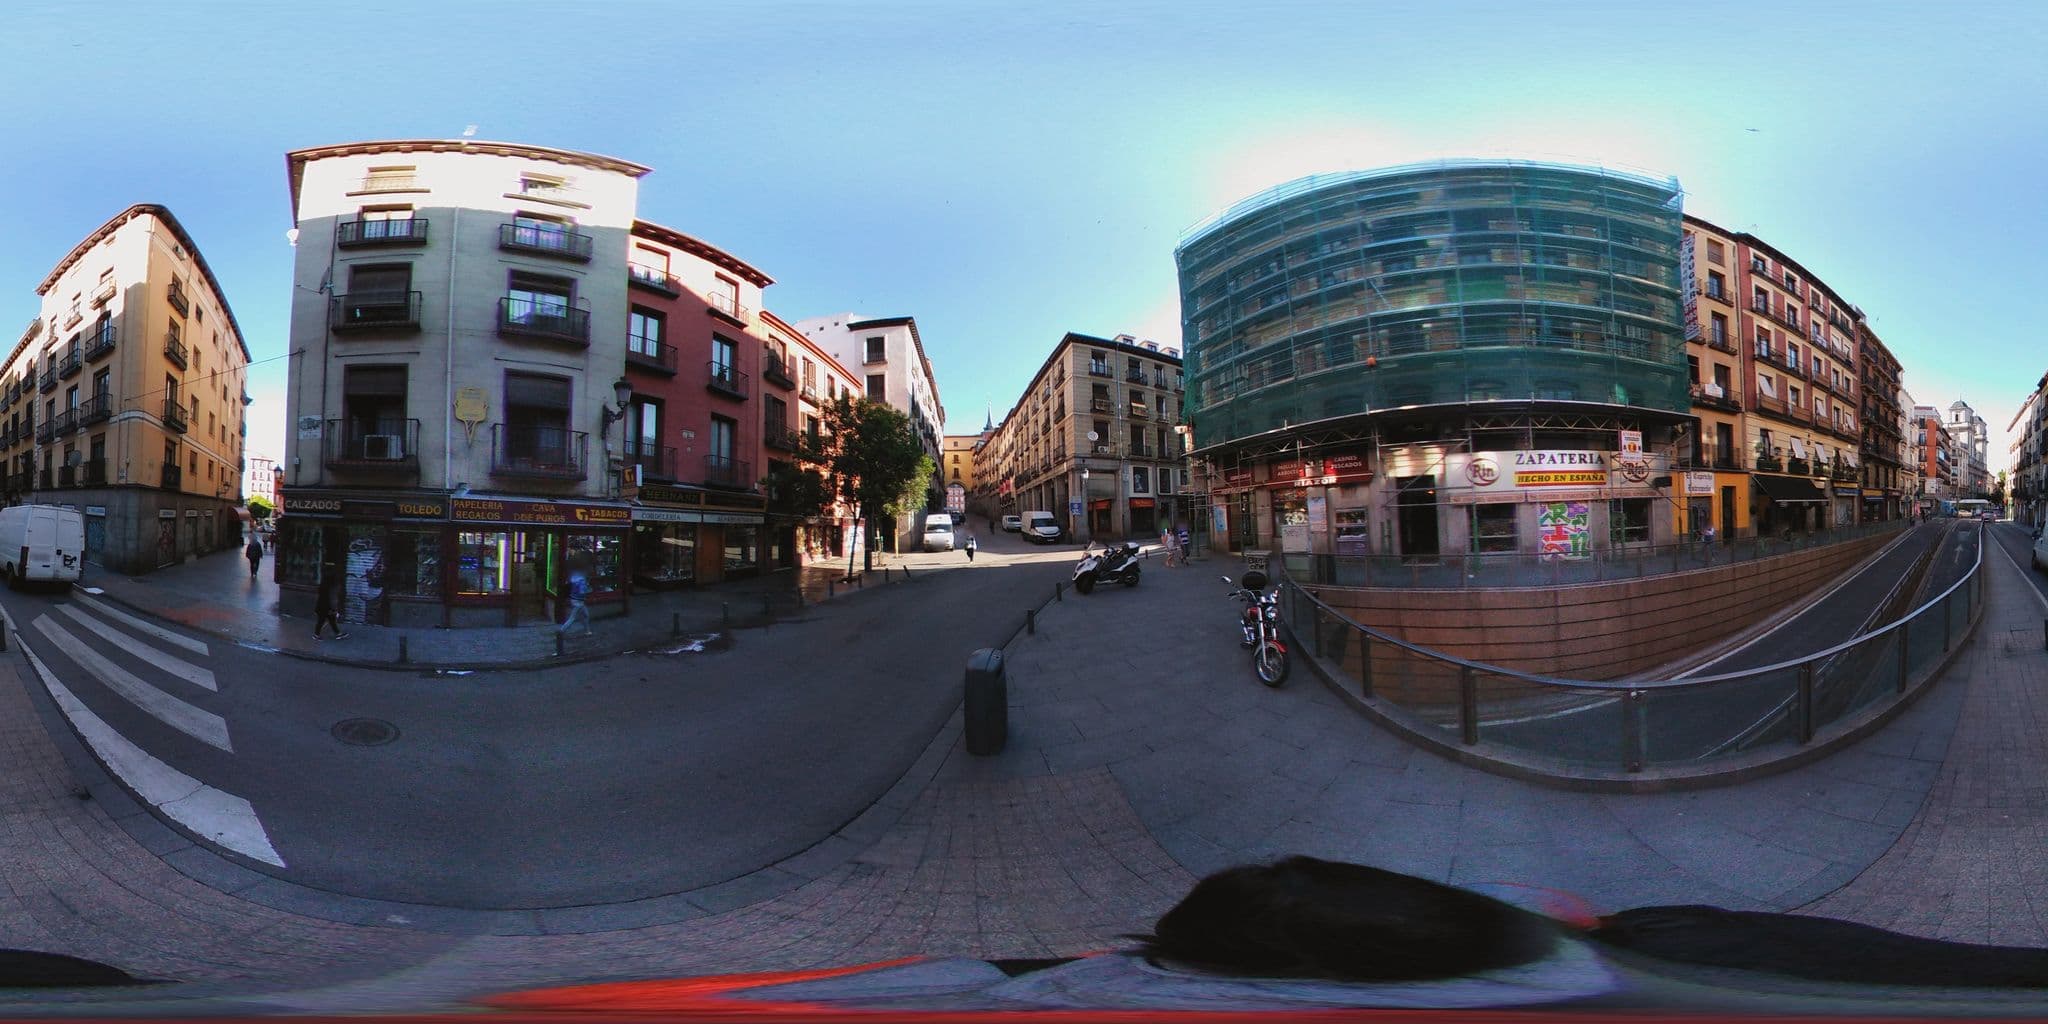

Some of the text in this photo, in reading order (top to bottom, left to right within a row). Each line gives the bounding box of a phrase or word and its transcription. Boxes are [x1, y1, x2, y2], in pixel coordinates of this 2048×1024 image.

[1515, 453, 1605, 465] ZAPATERIA
[1517, 471, 1605, 483] HECHO EN ESPAÑA
[285, 499, 341, 511] CALZADOS
[399, 503, 442, 515] TOLEDO
[453, 500, 503, 511] PAPELERIA
[532, 503, 556, 512] CAVA
[456, 510, 501, 520] REGALOS
[590, 509, 628, 518] TABACOS
